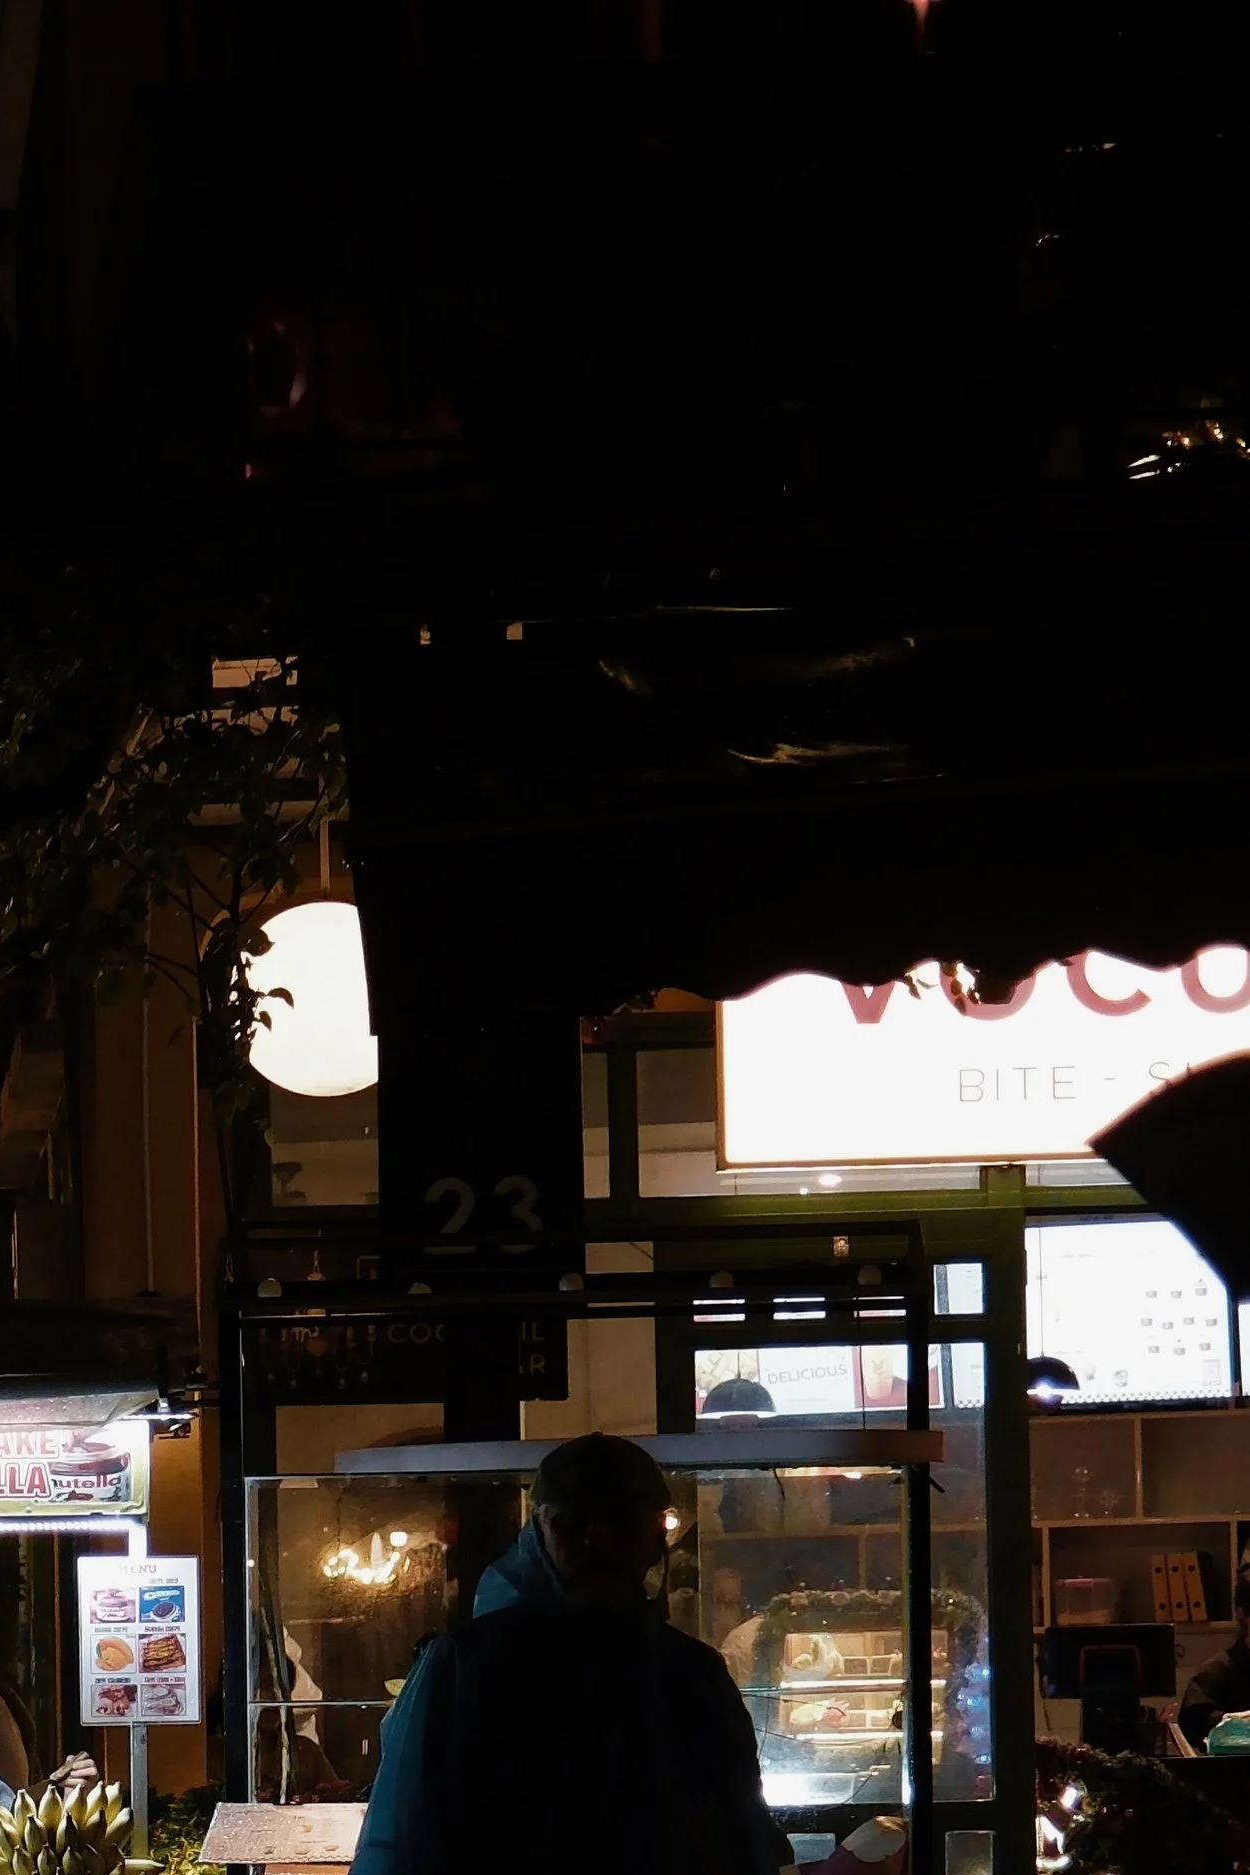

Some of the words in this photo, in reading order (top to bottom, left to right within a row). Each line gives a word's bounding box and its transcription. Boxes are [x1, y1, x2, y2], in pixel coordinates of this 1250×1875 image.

[958, 1065, 1077, 1103] BITE
[423, 1174, 544, 1255] 23
[767, 1363, 848, 1385] DELICIOUS
